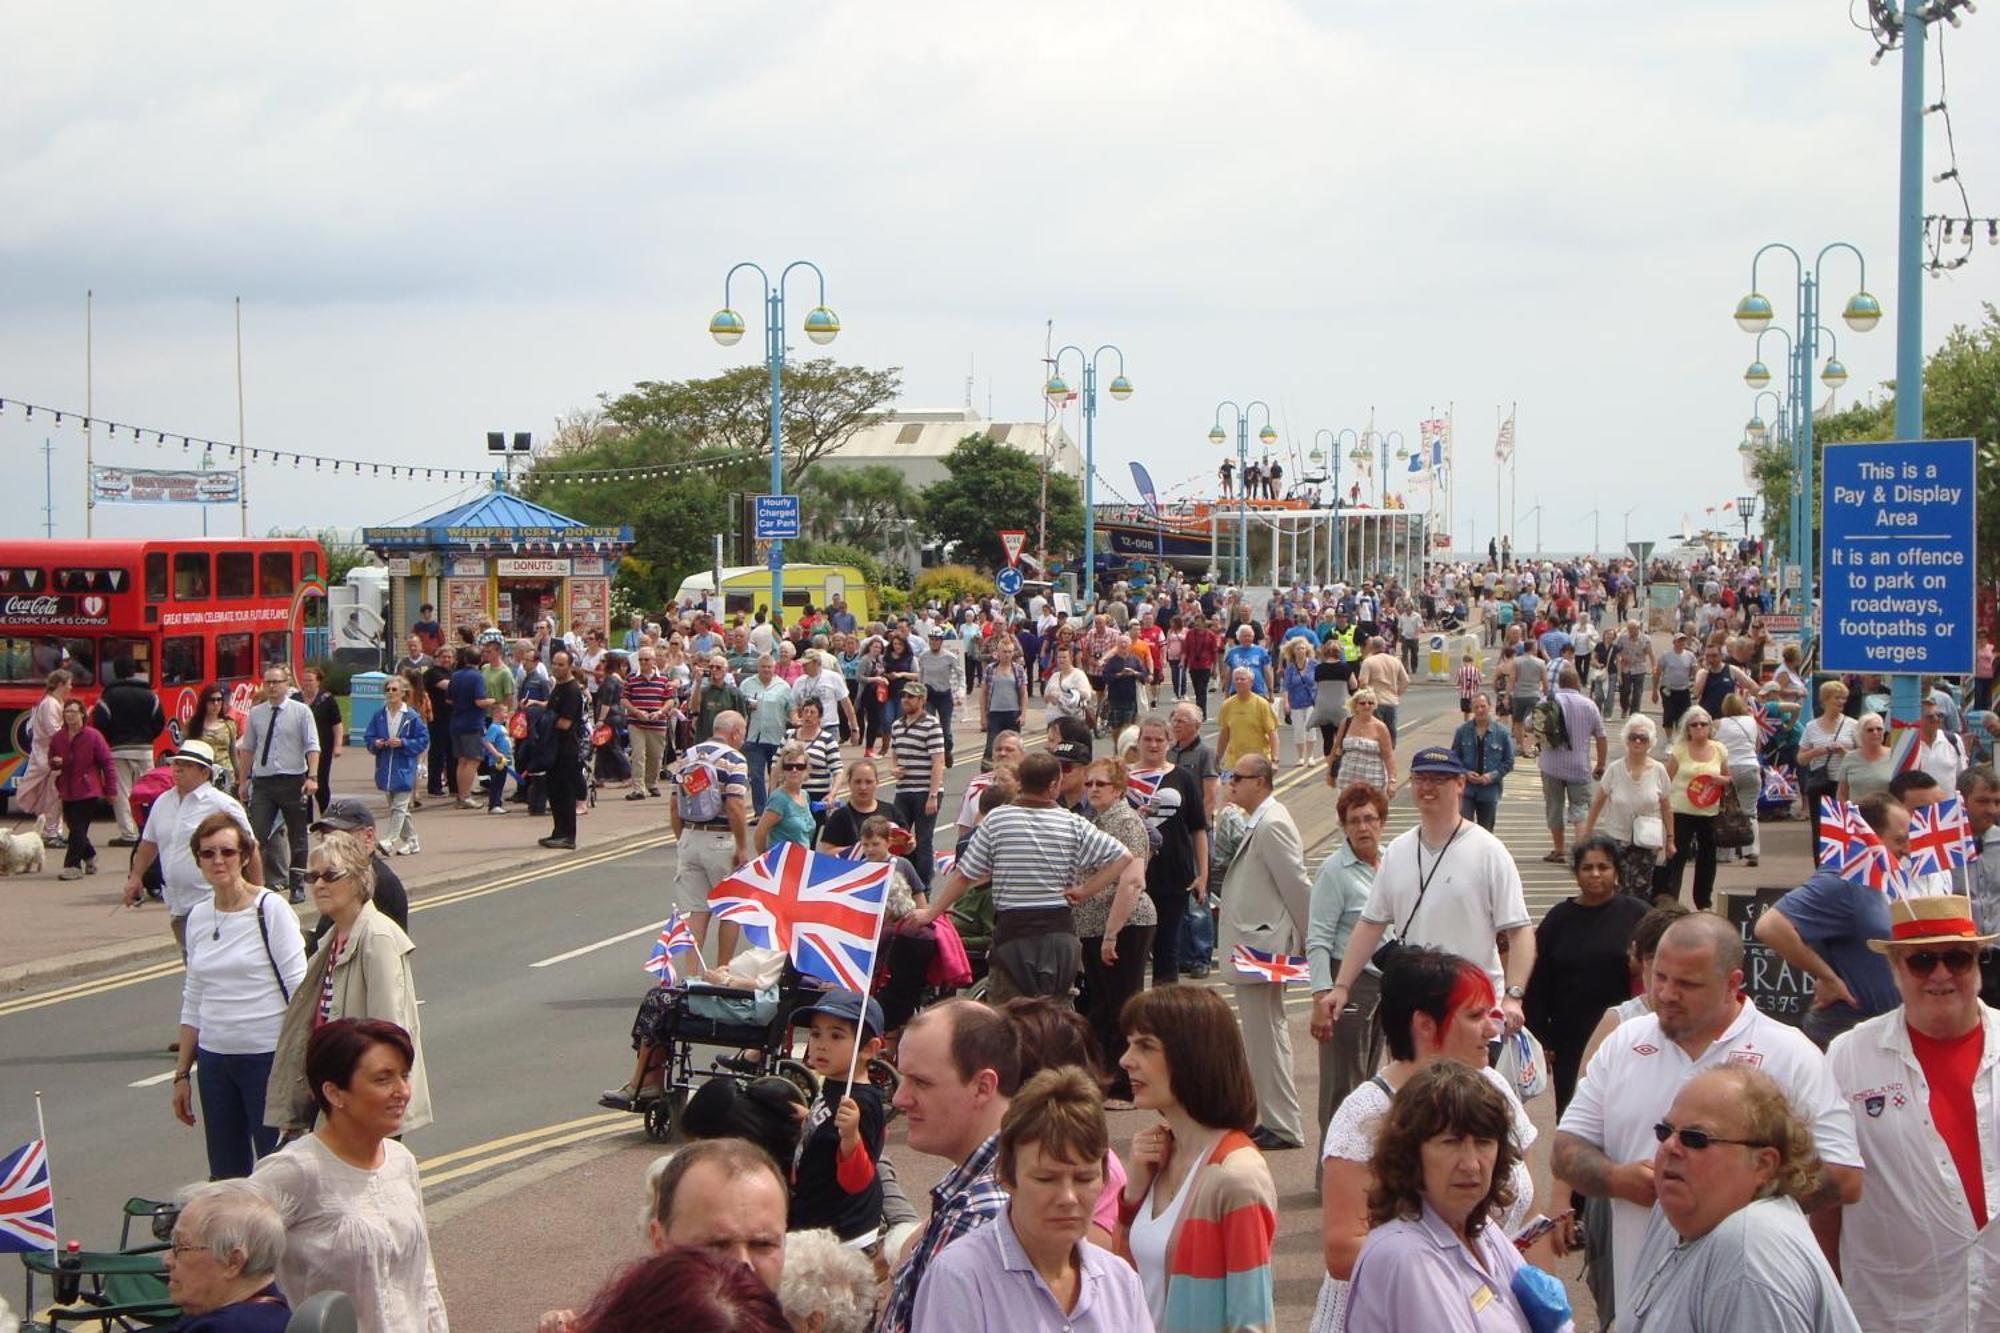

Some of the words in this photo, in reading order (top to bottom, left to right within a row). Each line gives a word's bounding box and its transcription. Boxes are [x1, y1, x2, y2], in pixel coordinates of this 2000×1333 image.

[1858, 462, 1895, 481] This
[1902, 462, 1918, 479] is
[1925, 464, 1937, 478] a
[763, 498, 791, 508] Hourly
[1834, 486, 1866, 507] Pay
[1872, 485, 1886, 504] &
[1894, 484, 1962, 506] Display
[760, 509, 796, 518] Charged
[1875, 509, 1919, 526] Area
[447, 527, 513, 537] WHIPPED
[565, 527, 620, 537] DONUTS
[760, 519, 775, 528] Car
[777, 519, 796, 528] Park
[1832, 549, 1843, 565] It
[1850, 548, 1863, 565] is
[1869, 551, 1890, 565] an
[1897, 548, 1964, 565] offence
[513, 560, 553, 571] DONUTS
[1848, 572, 1867, 589] to
[1874, 572, 1915, 592] park
[1923, 575, 1946, 589] on
[1850, 596, 1943, 616] roadways,
[41, 616, 65, 625] FLAME
[163, 613, 182, 625] GREAT
[182, 612, 204, 624] BRITAIN
[205, 611, 234, 623] CELEBRATE
[235, 610, 250, 621] YOUR
[1840, 619, 1927, 639] footpaths
[1935, 622, 1955, 637] or
[1865, 645, 1927, 663] verges
